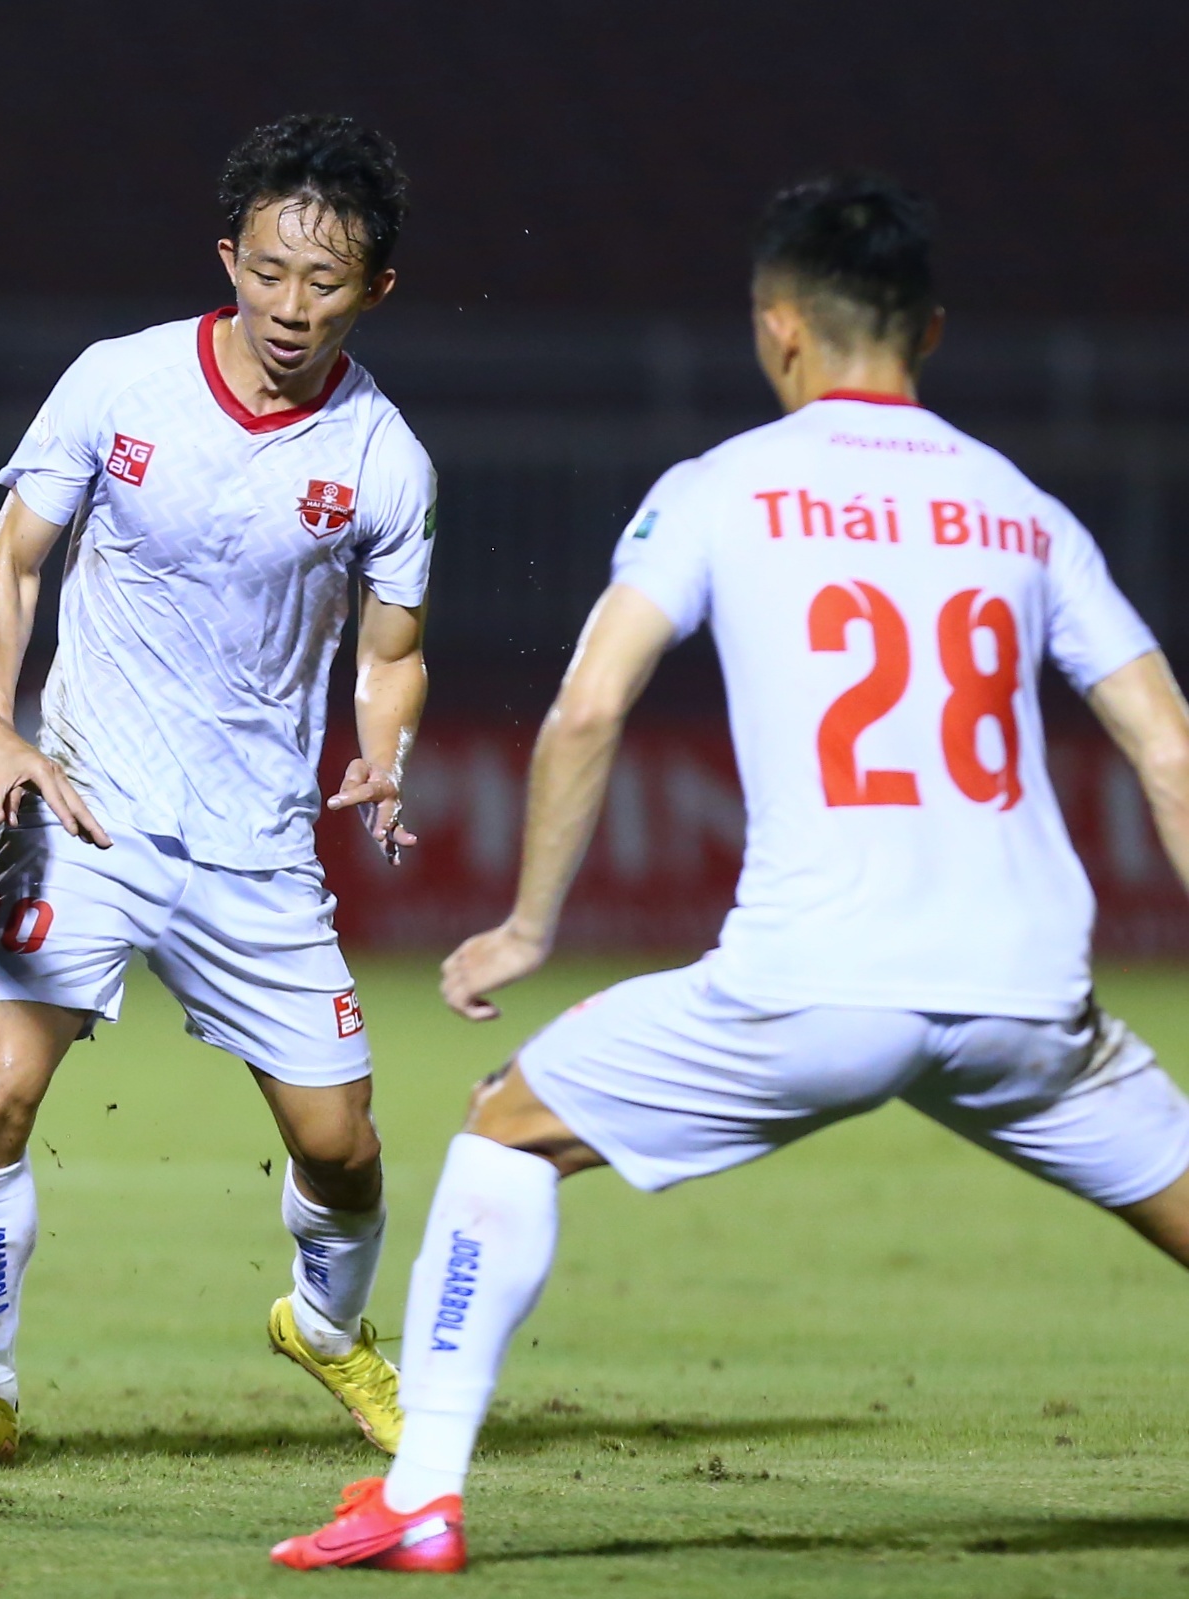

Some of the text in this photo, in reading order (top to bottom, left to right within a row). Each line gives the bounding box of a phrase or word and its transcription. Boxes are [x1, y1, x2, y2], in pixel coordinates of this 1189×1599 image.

[754, 489, 899, 544] Thái
[807, 579, 1025, 812] 28
[430, 1229, 482, 1350] JOGARBOLA
